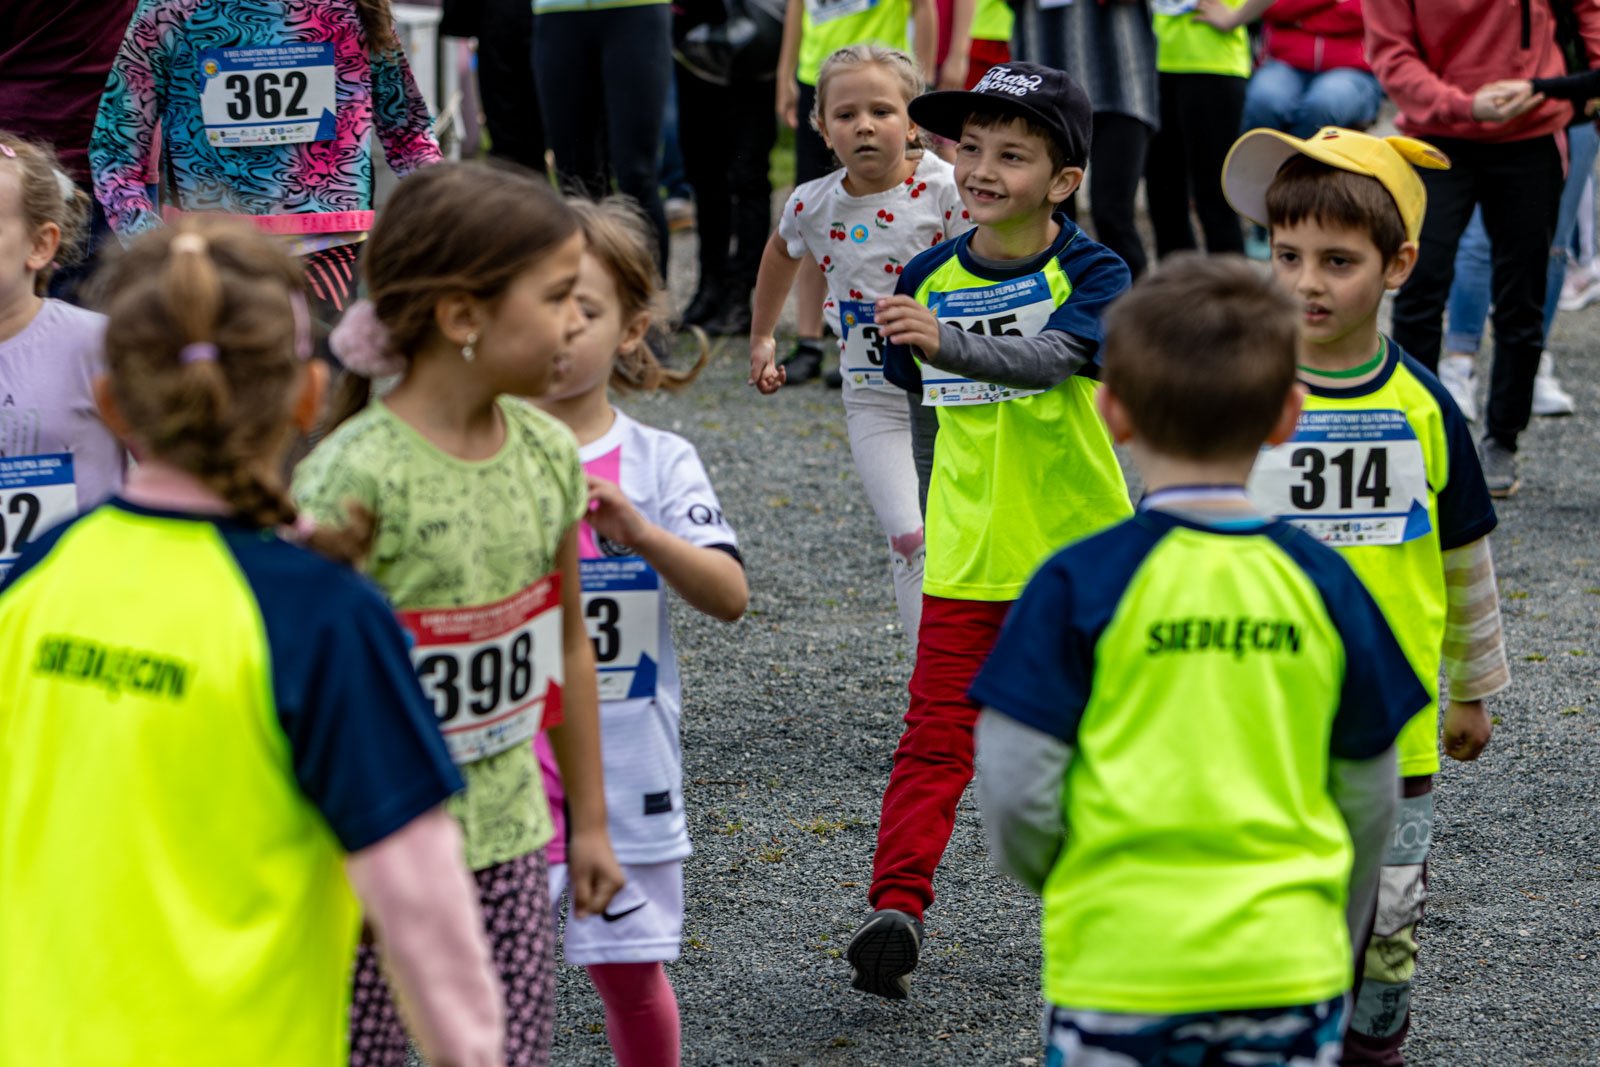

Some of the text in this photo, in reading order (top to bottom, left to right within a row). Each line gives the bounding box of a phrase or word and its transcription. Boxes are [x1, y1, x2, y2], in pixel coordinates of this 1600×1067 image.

[225, 71, 309, 120] 362
[1289, 447, 1391, 511] 314
[0, 492, 41, 553] 2
[415, 631, 532, 723] 398
